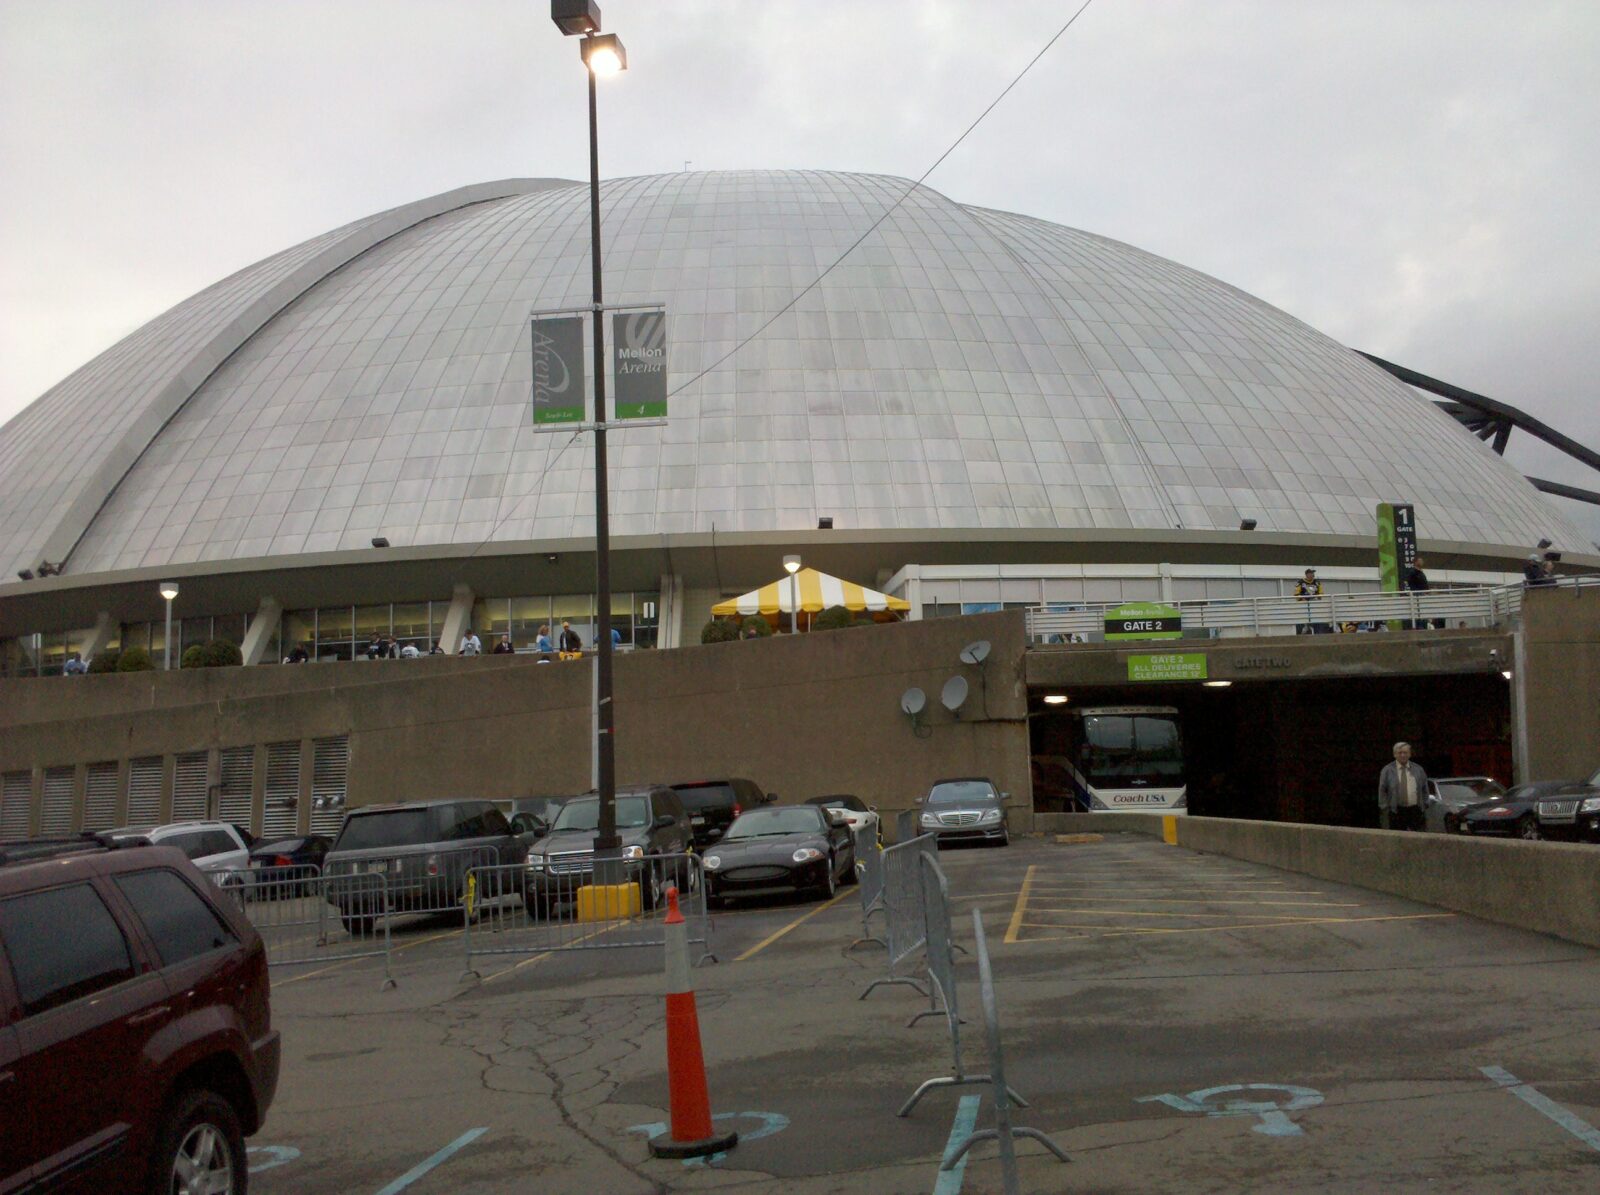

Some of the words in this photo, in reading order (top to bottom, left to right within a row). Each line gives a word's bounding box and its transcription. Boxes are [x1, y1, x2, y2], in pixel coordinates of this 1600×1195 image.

[618, 347, 662, 360] Mellon
[618, 360, 662, 374] Arena
[1398, 508, 1408, 524] 1
[1123, 621, 1153, 631] GATE
[1155, 621, 1162, 630] 2
[1150, 655, 1176, 664] GATE
[1178, 655, 1184, 664] 2
[1235, 655, 1263, 668] GATE
[1265, 655, 1292, 667] TWO
[1133, 664, 1150, 672] ALL
[1152, 663, 1201, 671] DELIVERIES
[1134, 671, 1188, 679] CLEARANCE
[1113, 794, 1145, 803] Coach
[1145, 794, 1166, 803] USA
